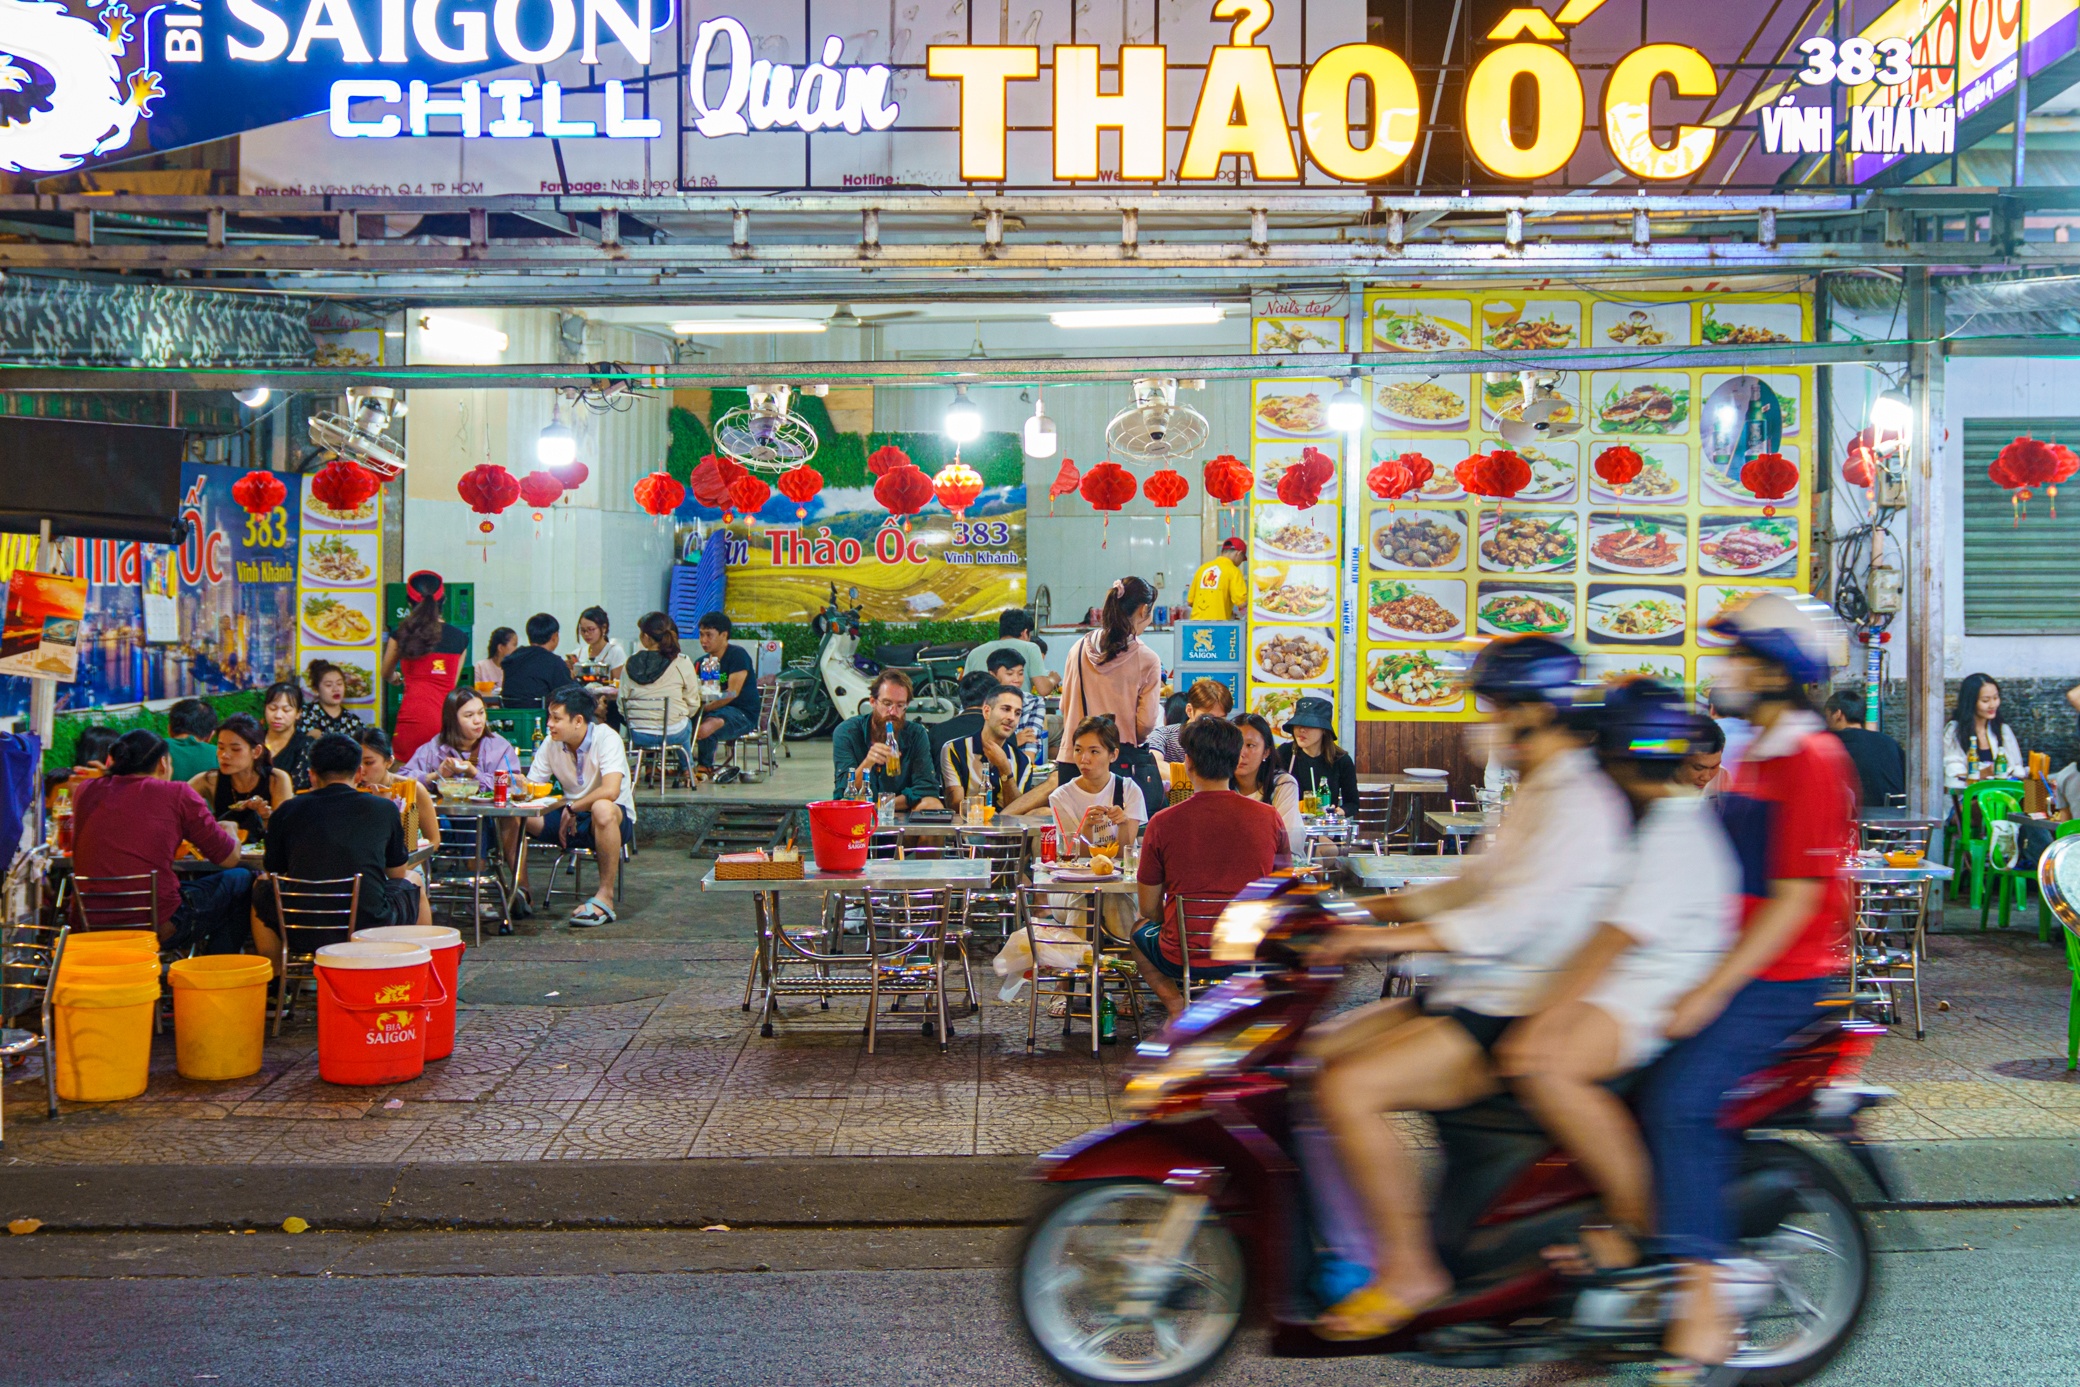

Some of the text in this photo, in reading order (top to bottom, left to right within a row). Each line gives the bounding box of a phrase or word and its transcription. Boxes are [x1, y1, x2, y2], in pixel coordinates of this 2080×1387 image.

[226, 0, 652, 64] SAIGON
[1798, 36, 1913, 86] 383
[690, 16, 899, 137] Quán
[926, 0, 1718, 181] THẢO ỐC
[329, 79, 662, 138] CHILL
[1760, 93, 1956, 154] VĨNH KHÁNH
[451, 182, 484, 195] HCM
[611, 178, 640, 191] Nails
[842, 173, 900, 187] Hotline:
[1259, 299, 1300, 316] Nails
[242, 505, 288, 548] 383
[951, 521, 1009, 547] 383
[764, 526, 862, 567] Thảo
[875, 514, 929, 565] Ốc
[945, 551, 1018, 564] Vĩnh Khánh
[236, 560, 293, 583] Vĩnh Khánh
[1189, 651, 1218, 659] SAIGON
[1229, 628, 1237, 660] CHILL
[366, 1028, 416, 1045] SAIGON
[385, 1023, 402, 1032] BIA
